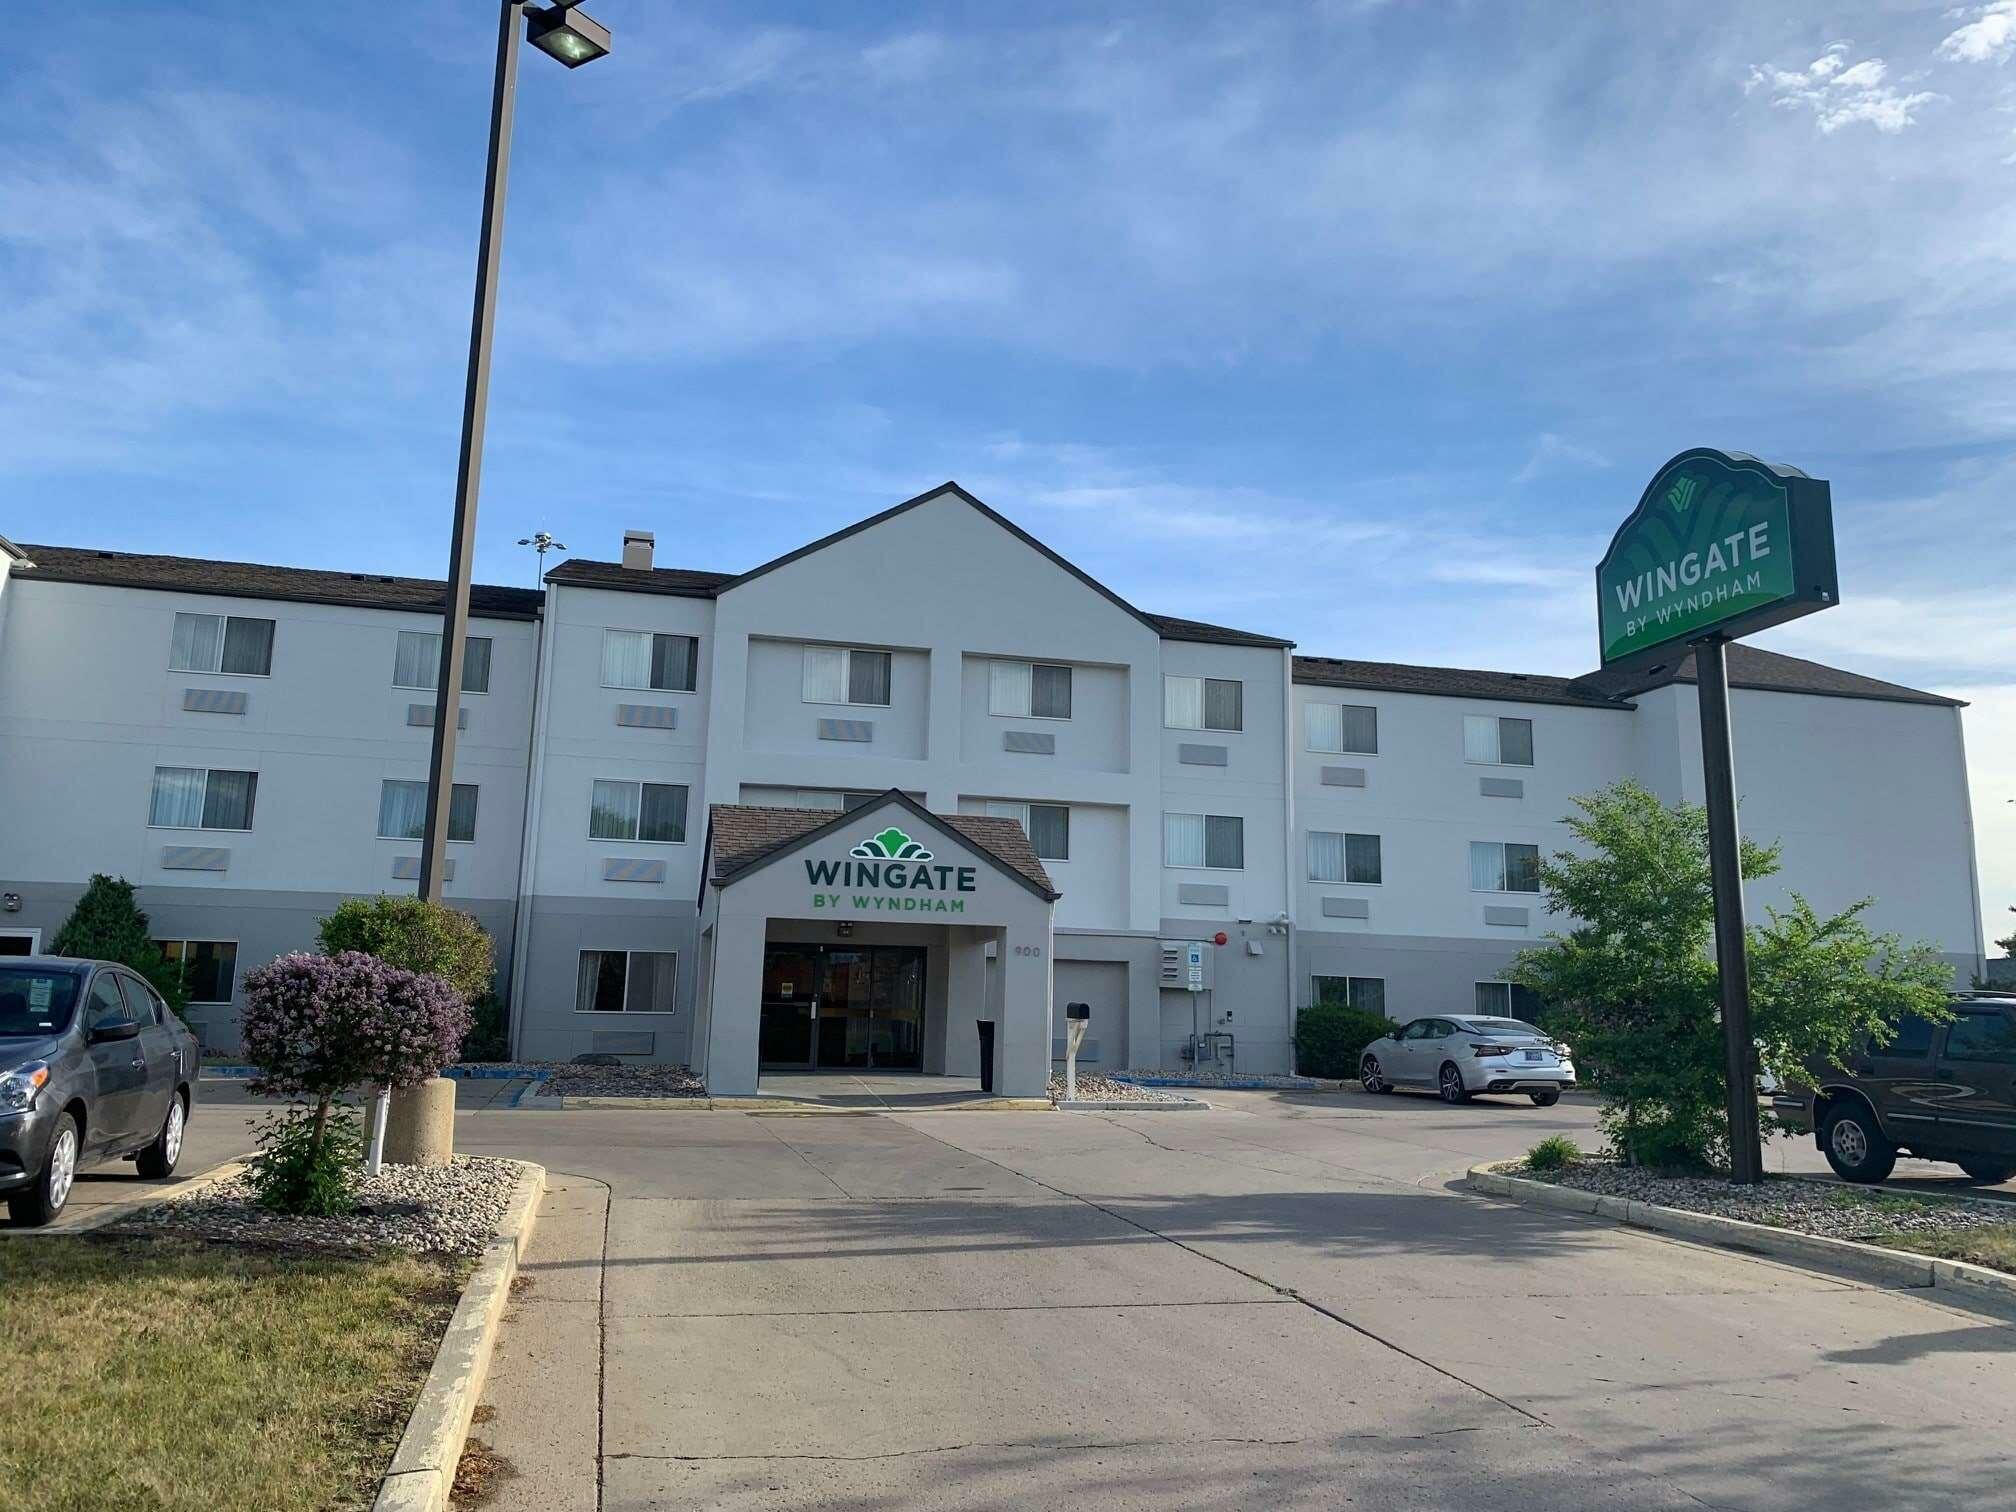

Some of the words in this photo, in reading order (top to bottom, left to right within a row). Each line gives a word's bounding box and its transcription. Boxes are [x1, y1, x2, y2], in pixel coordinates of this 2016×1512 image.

[1615, 521, 1770, 613] WINGATE
[1626, 616, 1647, 637] BY
[1656, 571, 1761, 625] WYNDHAM
[804, 859, 977, 892] WINGATE
[813, 893, 841, 908] BY
[852, 895, 965, 913] WYNDHAM
[1014, 945, 1041, 958] 900
